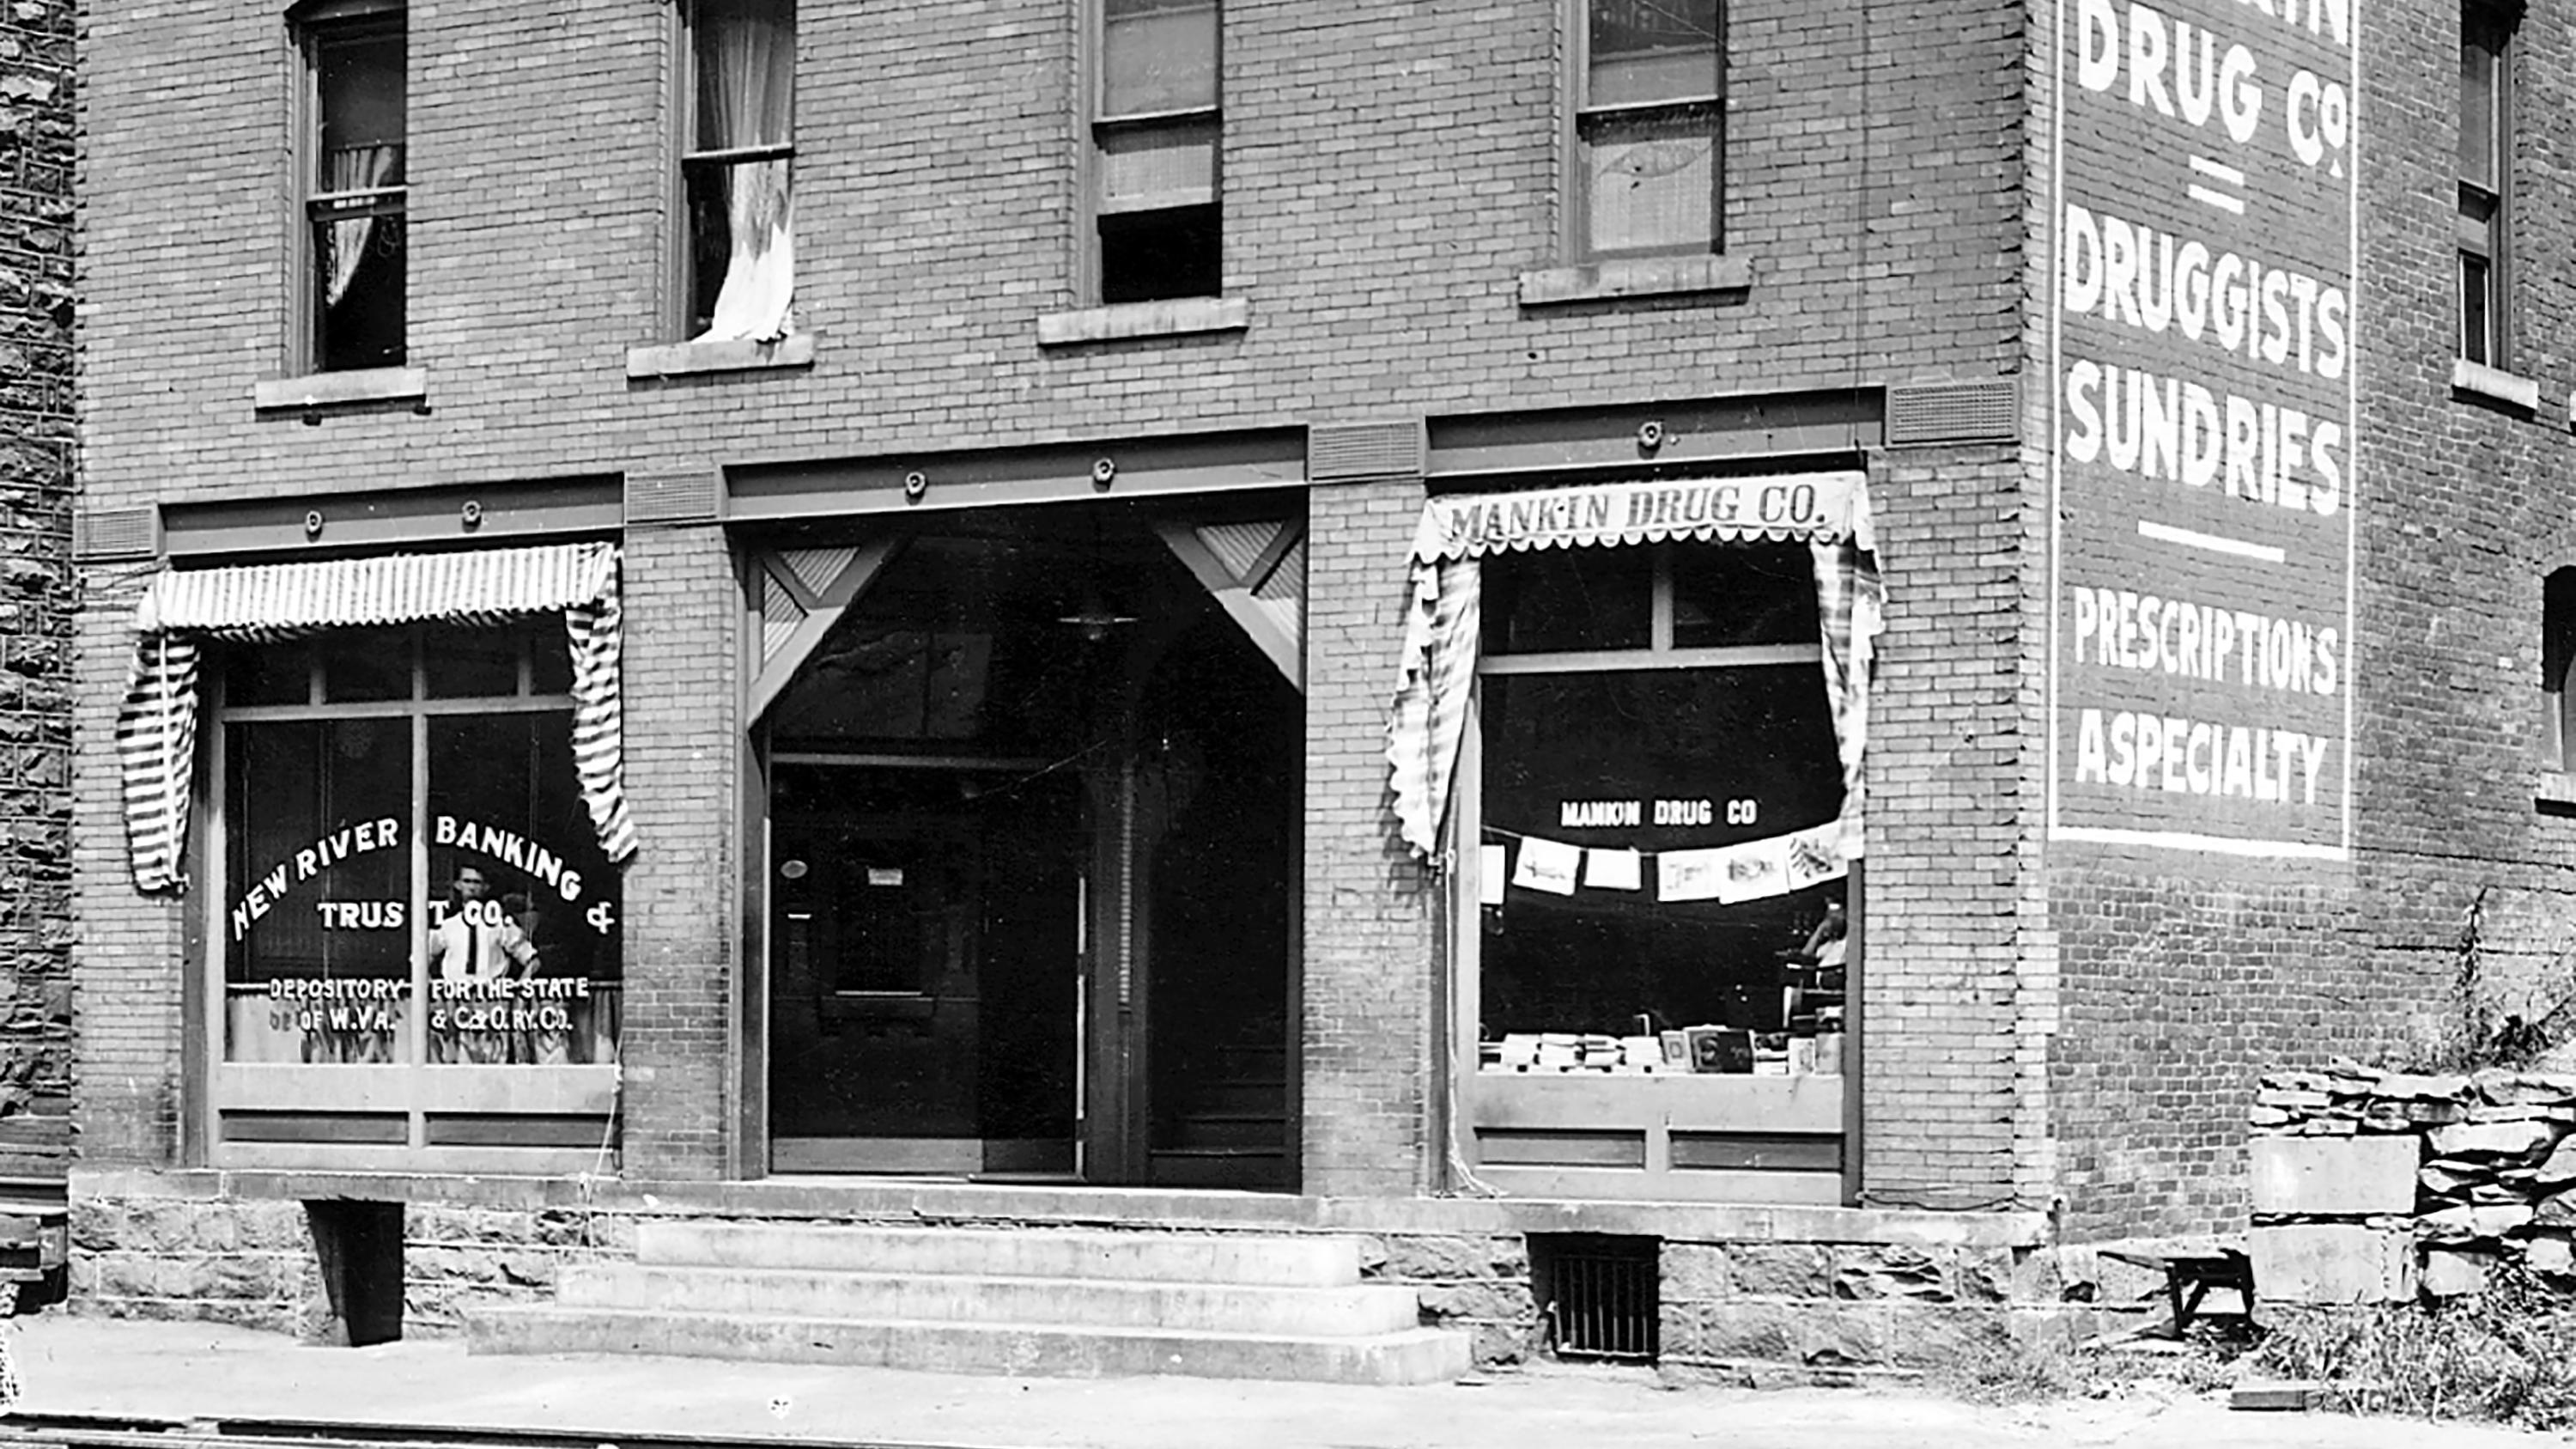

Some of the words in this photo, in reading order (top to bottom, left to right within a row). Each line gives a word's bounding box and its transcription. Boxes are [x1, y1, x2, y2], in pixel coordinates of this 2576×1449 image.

[2076, 0, 2263, 144] DRUG
[2064, 202, 2348, 379] DRUGGISTS
[2065, 359, 2342, 515] SUNDRIES
[1451, 495, 1609, 536] MANKIN
[1626, 484, 1741, 527] DRUG
[1758, 483, 1826, 524] CO.
[2074, 586, 2339, 696] PRESCRIPTIONS
[1560, 801, 1641, 827] MANKIN
[1654, 801, 1713, 825] DRUG
[1727, 800, 1758, 825] CO
[231, 863, 289, 942] NEW
[295, 817, 400, 881] RIVER
[435, 815, 583, 902] BANKING
[586, 901, 616, 935] &
[270, 978, 406, 1000] DEPOSITORY
[519, 977, 590, 999] STATE
[301, 1010, 324, 1030] OF
[431, 1008, 447, 1031] &
